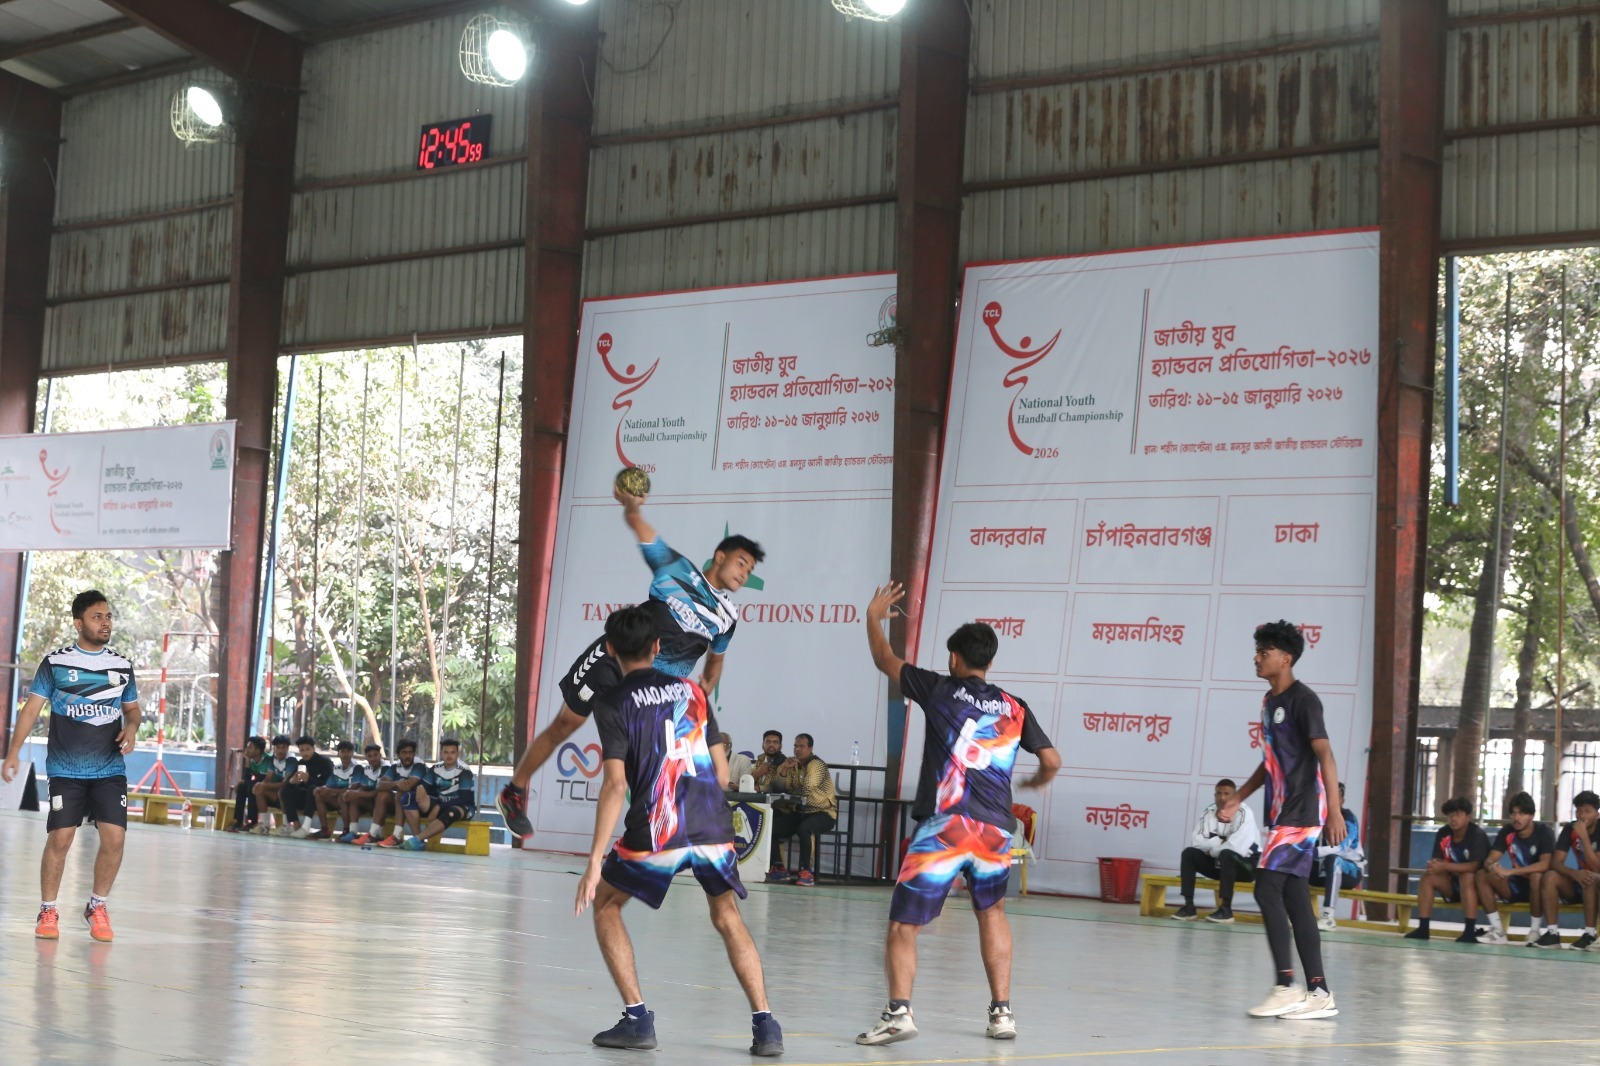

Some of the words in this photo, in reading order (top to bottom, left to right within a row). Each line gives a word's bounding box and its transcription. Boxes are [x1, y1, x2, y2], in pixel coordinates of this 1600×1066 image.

[419, 122, 470, 169] 12:45
[469, 143, 482, 162] 59
[984, 309, 1000, 318] TCL
[598, 339, 611, 347] TCL
[1154, 320, 1206, 347] জাতীয়
[1212, 325, 1236, 350] যুব
[733, 352, 774, 375] জাতীয়
[778, 355, 797, 378] যুব
[1151, 356, 1213, 378] হ্যান্ডবল
[730, 383, 779, 402] হ্যান্ডবল
[783, 373, 895, 398] প্রতিযোগিতা-২০২
[1244, 382, 1302, 410] জানুয়ারি
[1306, 386, 1343, 401] ২০২৬
[1019, 395, 1063, 409] National
[1065, 394, 1095, 407] Youth
[625, 418, 660, 430] National
[662, 416, 685, 428] Youth
[802, 407, 847, 431] জানুয়ারি
[851, 410, 880, 423] ২০২৬
[1017, 412, 1056, 424] Handball
[1058, 410, 1124, 424] Championship
[623, 432, 655, 443] Handball
[656, 431, 707, 443] Championship
[1034, 447, 1059, 458] 2026
[970, 526, 1047, 549] বান্দরবান
[1086, 520, 1212, 549] চাঁপাইনবাবগঞ্জ
[1275, 522, 1319, 544] ঢাকা
[818, 604, 861, 623] LTD.
[1091, 616, 1185, 646] ময়মনসিংহ
[68, 669, 79, 682] 3
[1083, 711, 1172, 743] জামালপুর
[665, 719, 697, 777] 4
[954, 718, 992, 770] 6
[556, 779, 599, 801] TCL
[120, 795, 127, 808] 3
[1086, 803, 1150, 831] নড়াইল
